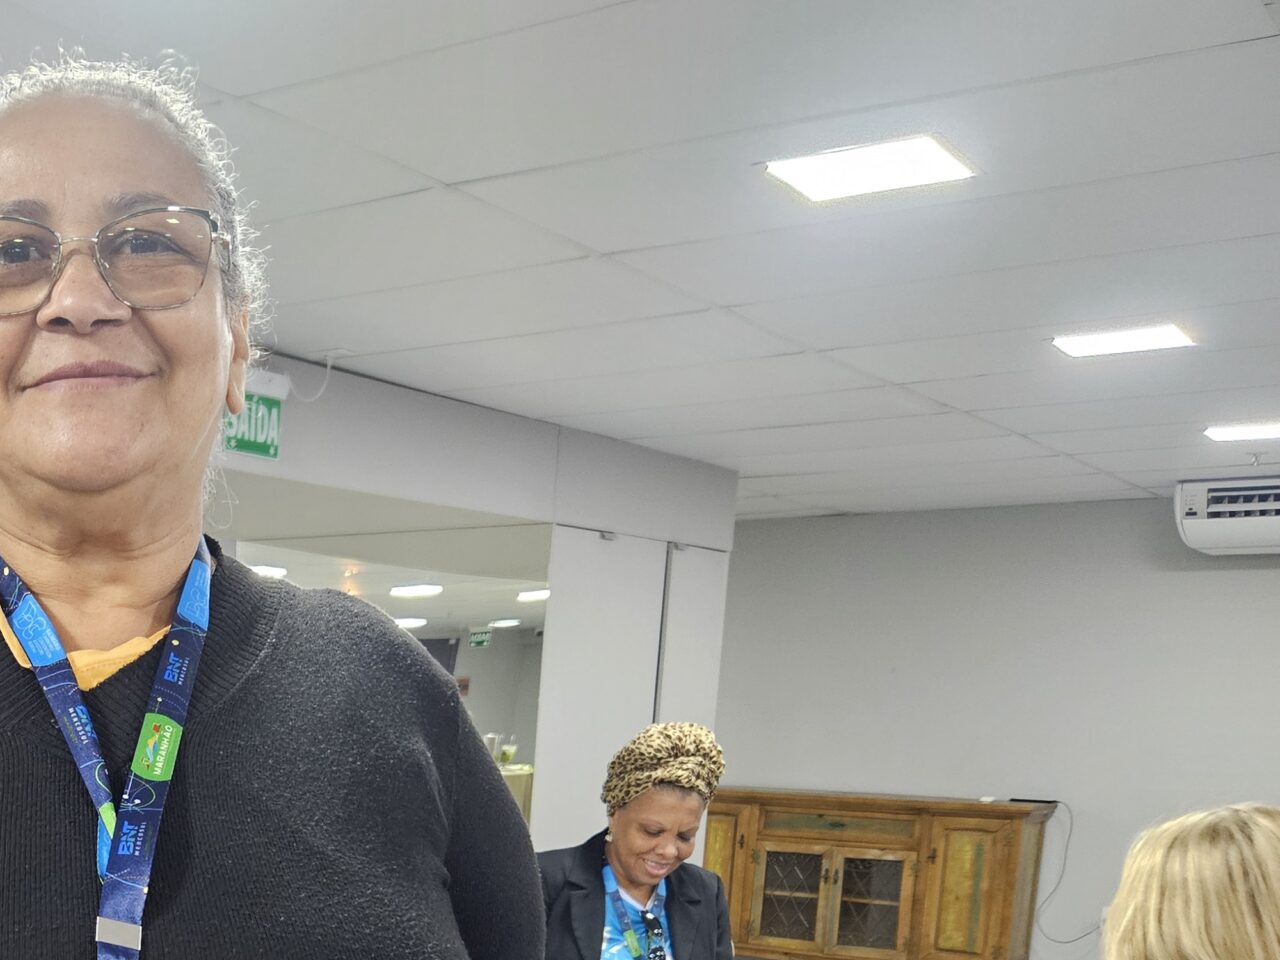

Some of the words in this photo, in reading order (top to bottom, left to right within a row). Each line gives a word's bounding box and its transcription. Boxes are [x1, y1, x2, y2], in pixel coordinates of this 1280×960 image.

[163, 652, 181, 683] BNT
[68, 707, 89, 745] MERCOSUL
[153, 724, 175, 776] MARANHÃO
[116, 820, 139, 856] BNT
